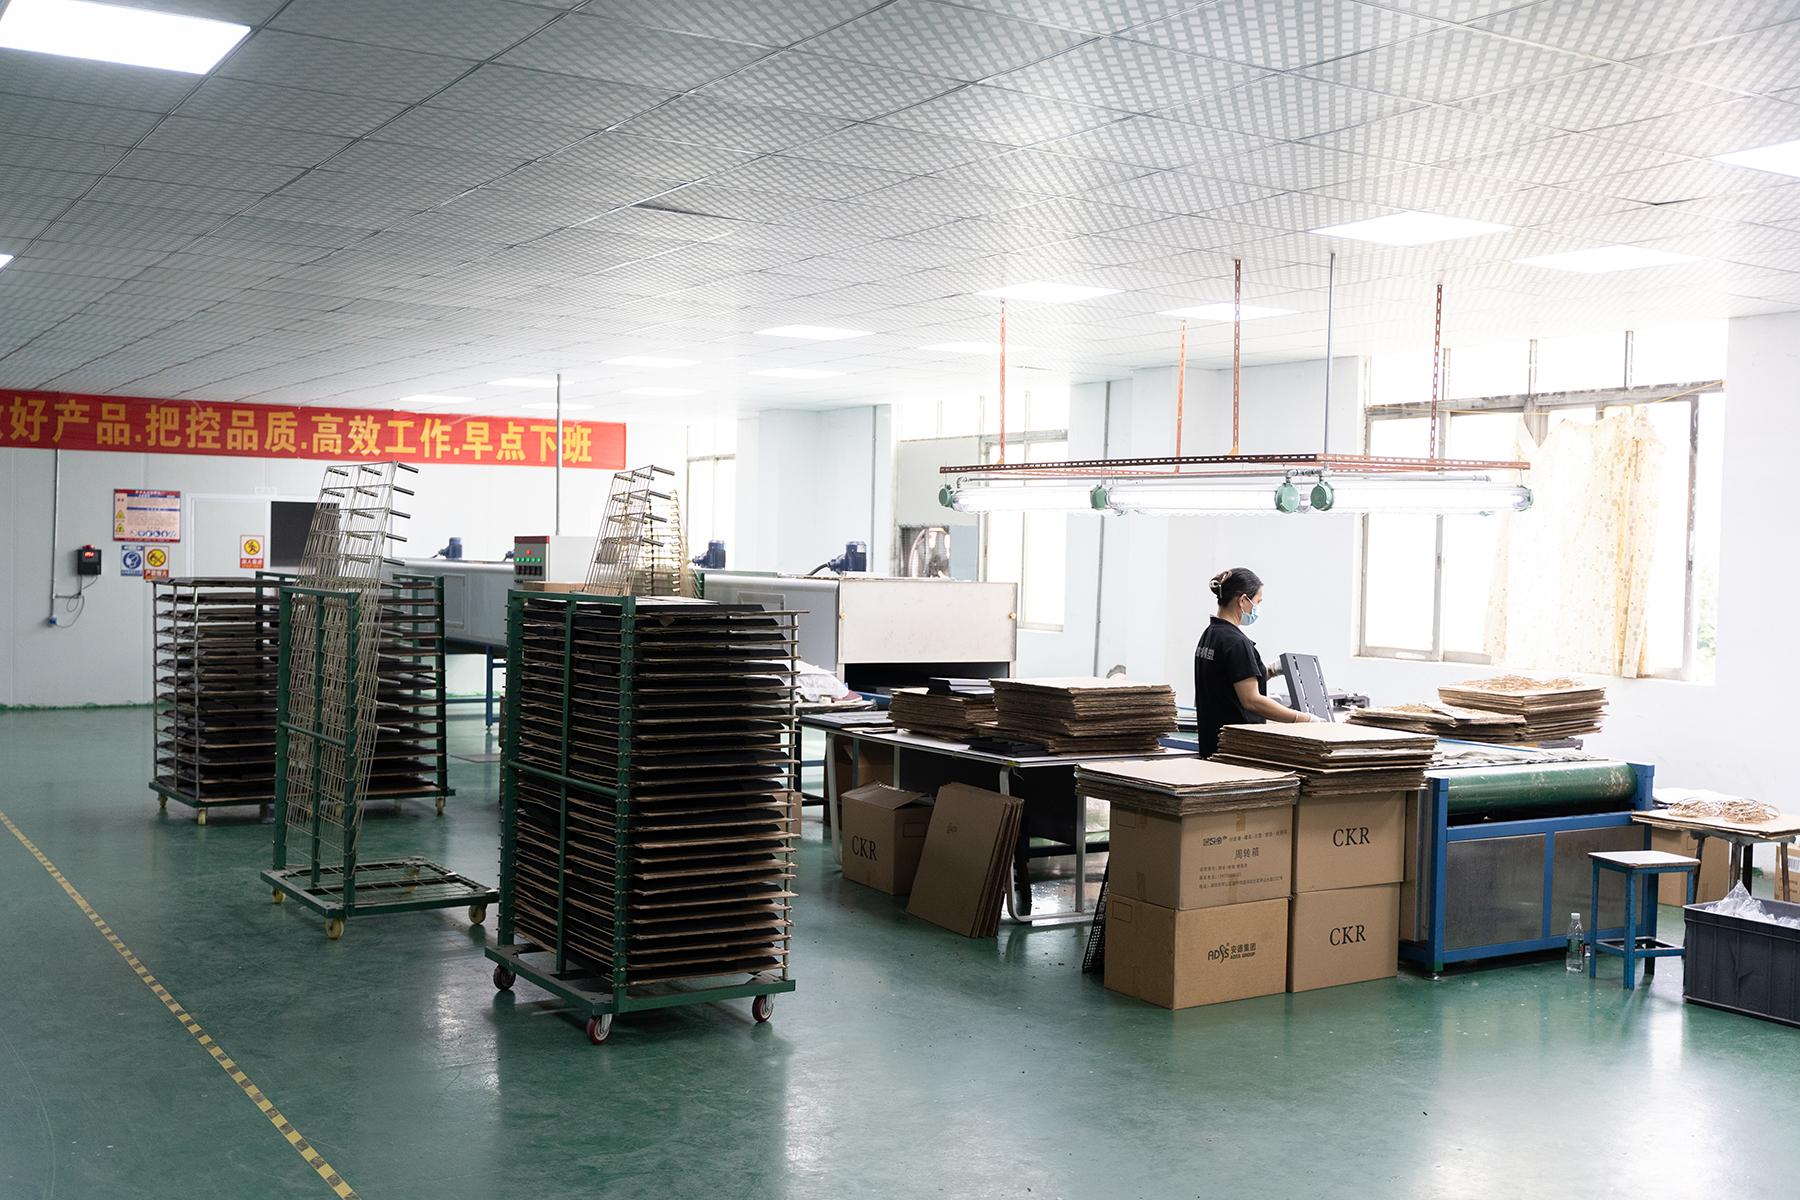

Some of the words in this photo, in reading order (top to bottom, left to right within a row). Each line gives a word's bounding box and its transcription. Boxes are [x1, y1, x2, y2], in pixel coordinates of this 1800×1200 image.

[0, 395, 592, 464] 好产品.把控品质.高效工作.早点下班
[852, 835, 878, 861] CKR
[1333, 827, 1370, 847] CKR
[1329, 925, 1366, 946] CKR
